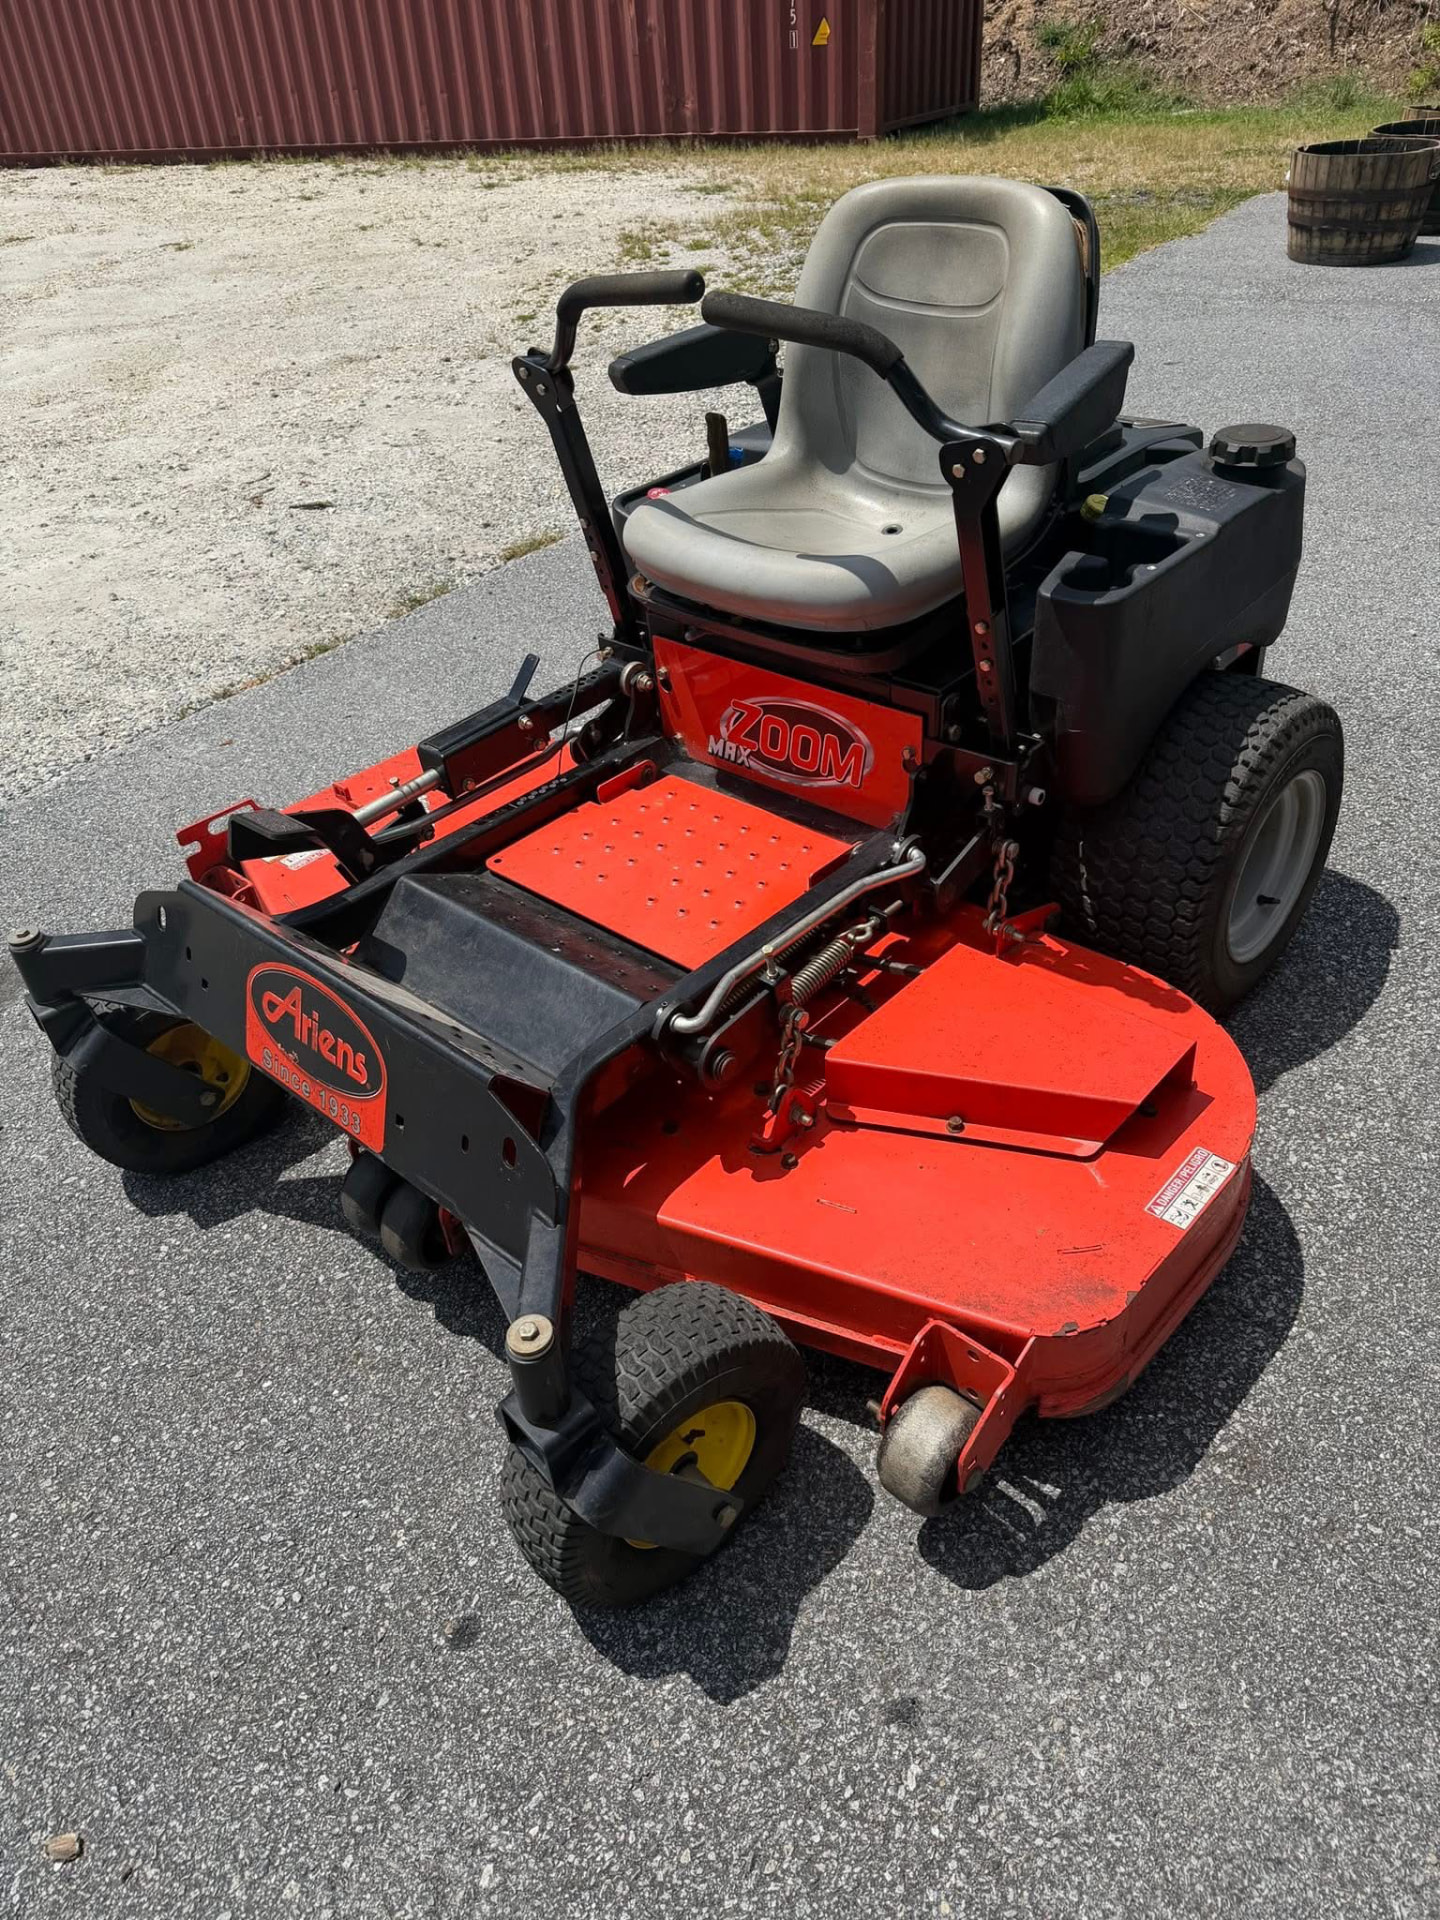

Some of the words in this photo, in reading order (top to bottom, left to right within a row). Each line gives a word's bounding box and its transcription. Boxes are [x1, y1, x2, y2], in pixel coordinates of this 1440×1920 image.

[708, 735, 750, 767] MAX
[726, 699, 865, 788] ZOOM
[262, 986, 368, 1085] Ariens
[262, 1047, 311, 1097] Since
[318, 1089, 361, 1135] 1933
